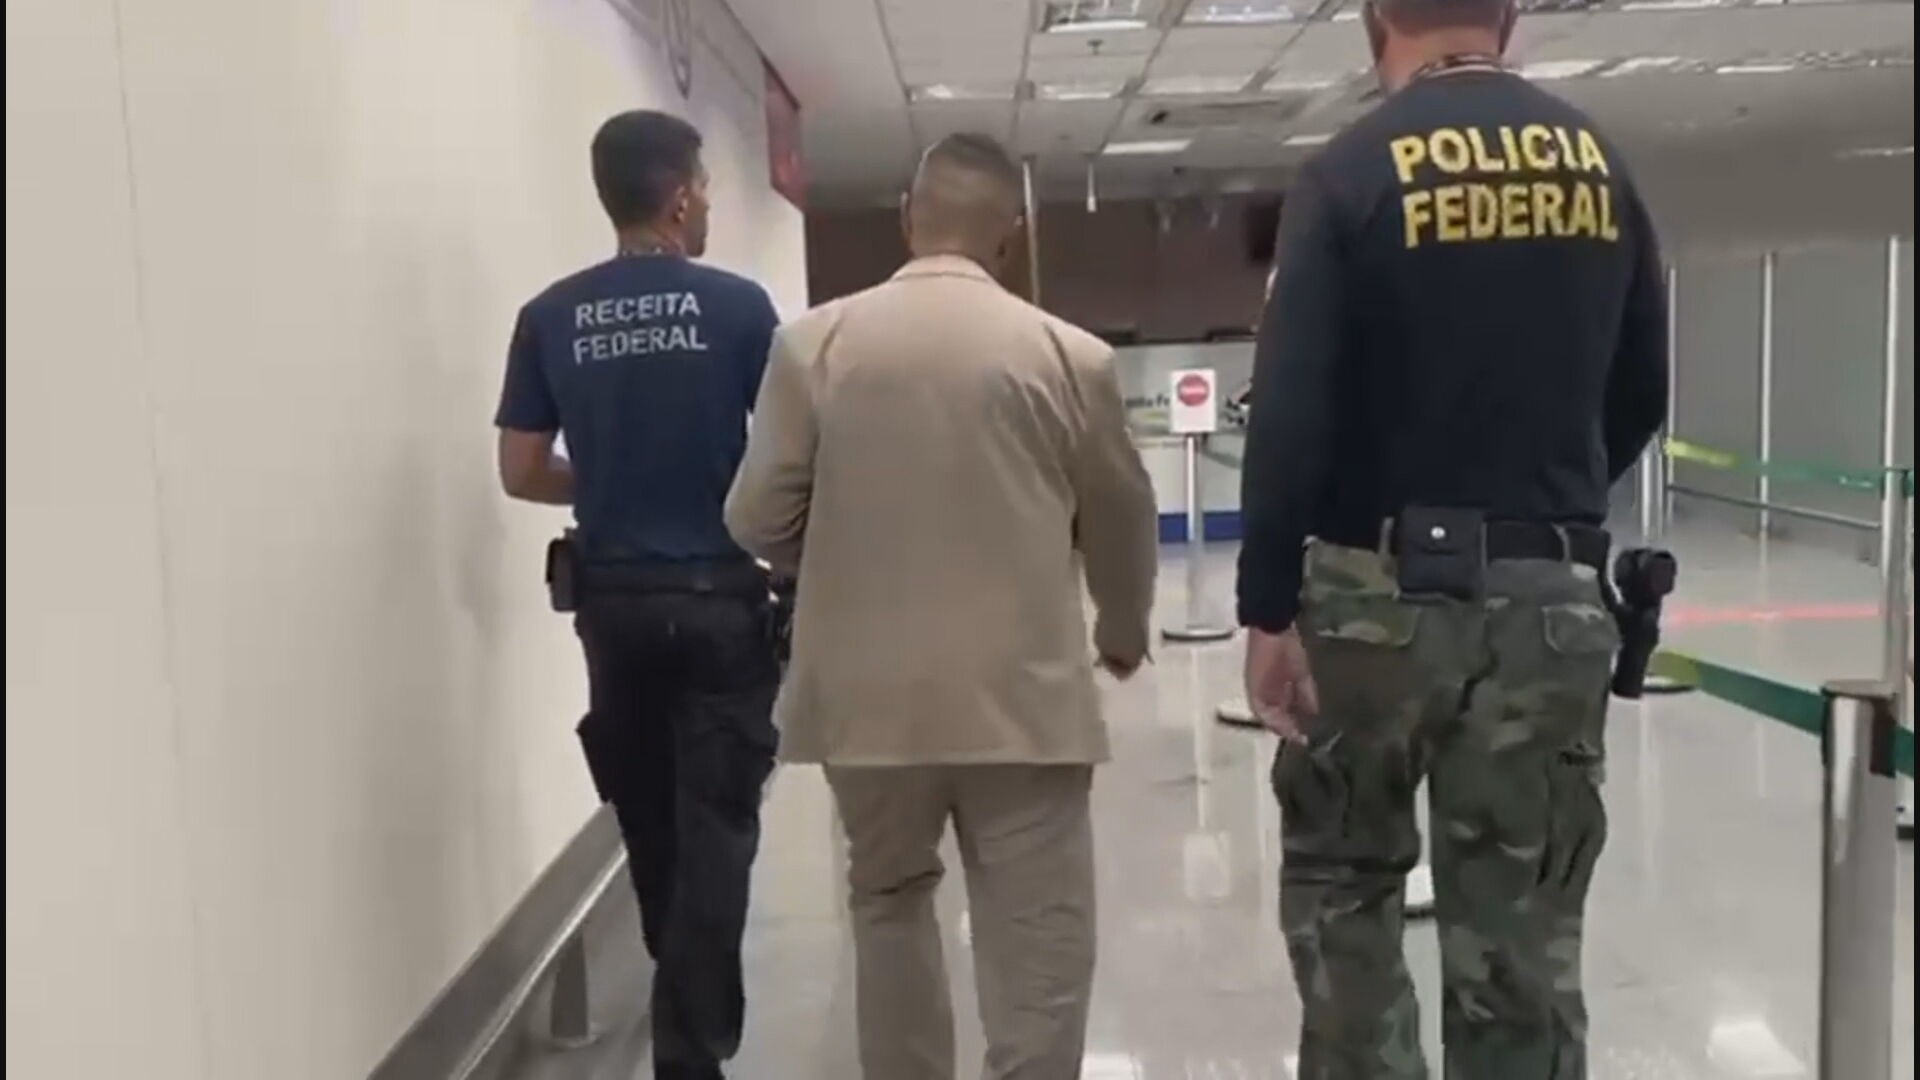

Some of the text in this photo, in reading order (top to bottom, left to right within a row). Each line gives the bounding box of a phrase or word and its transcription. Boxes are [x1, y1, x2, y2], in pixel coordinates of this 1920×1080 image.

[1390, 123, 1609, 184] POLICIA
[1402, 181, 1619, 249] FEDERAL
[575, 291, 701, 329] RECEITA
[573, 324, 708, 365] FEDERAL
